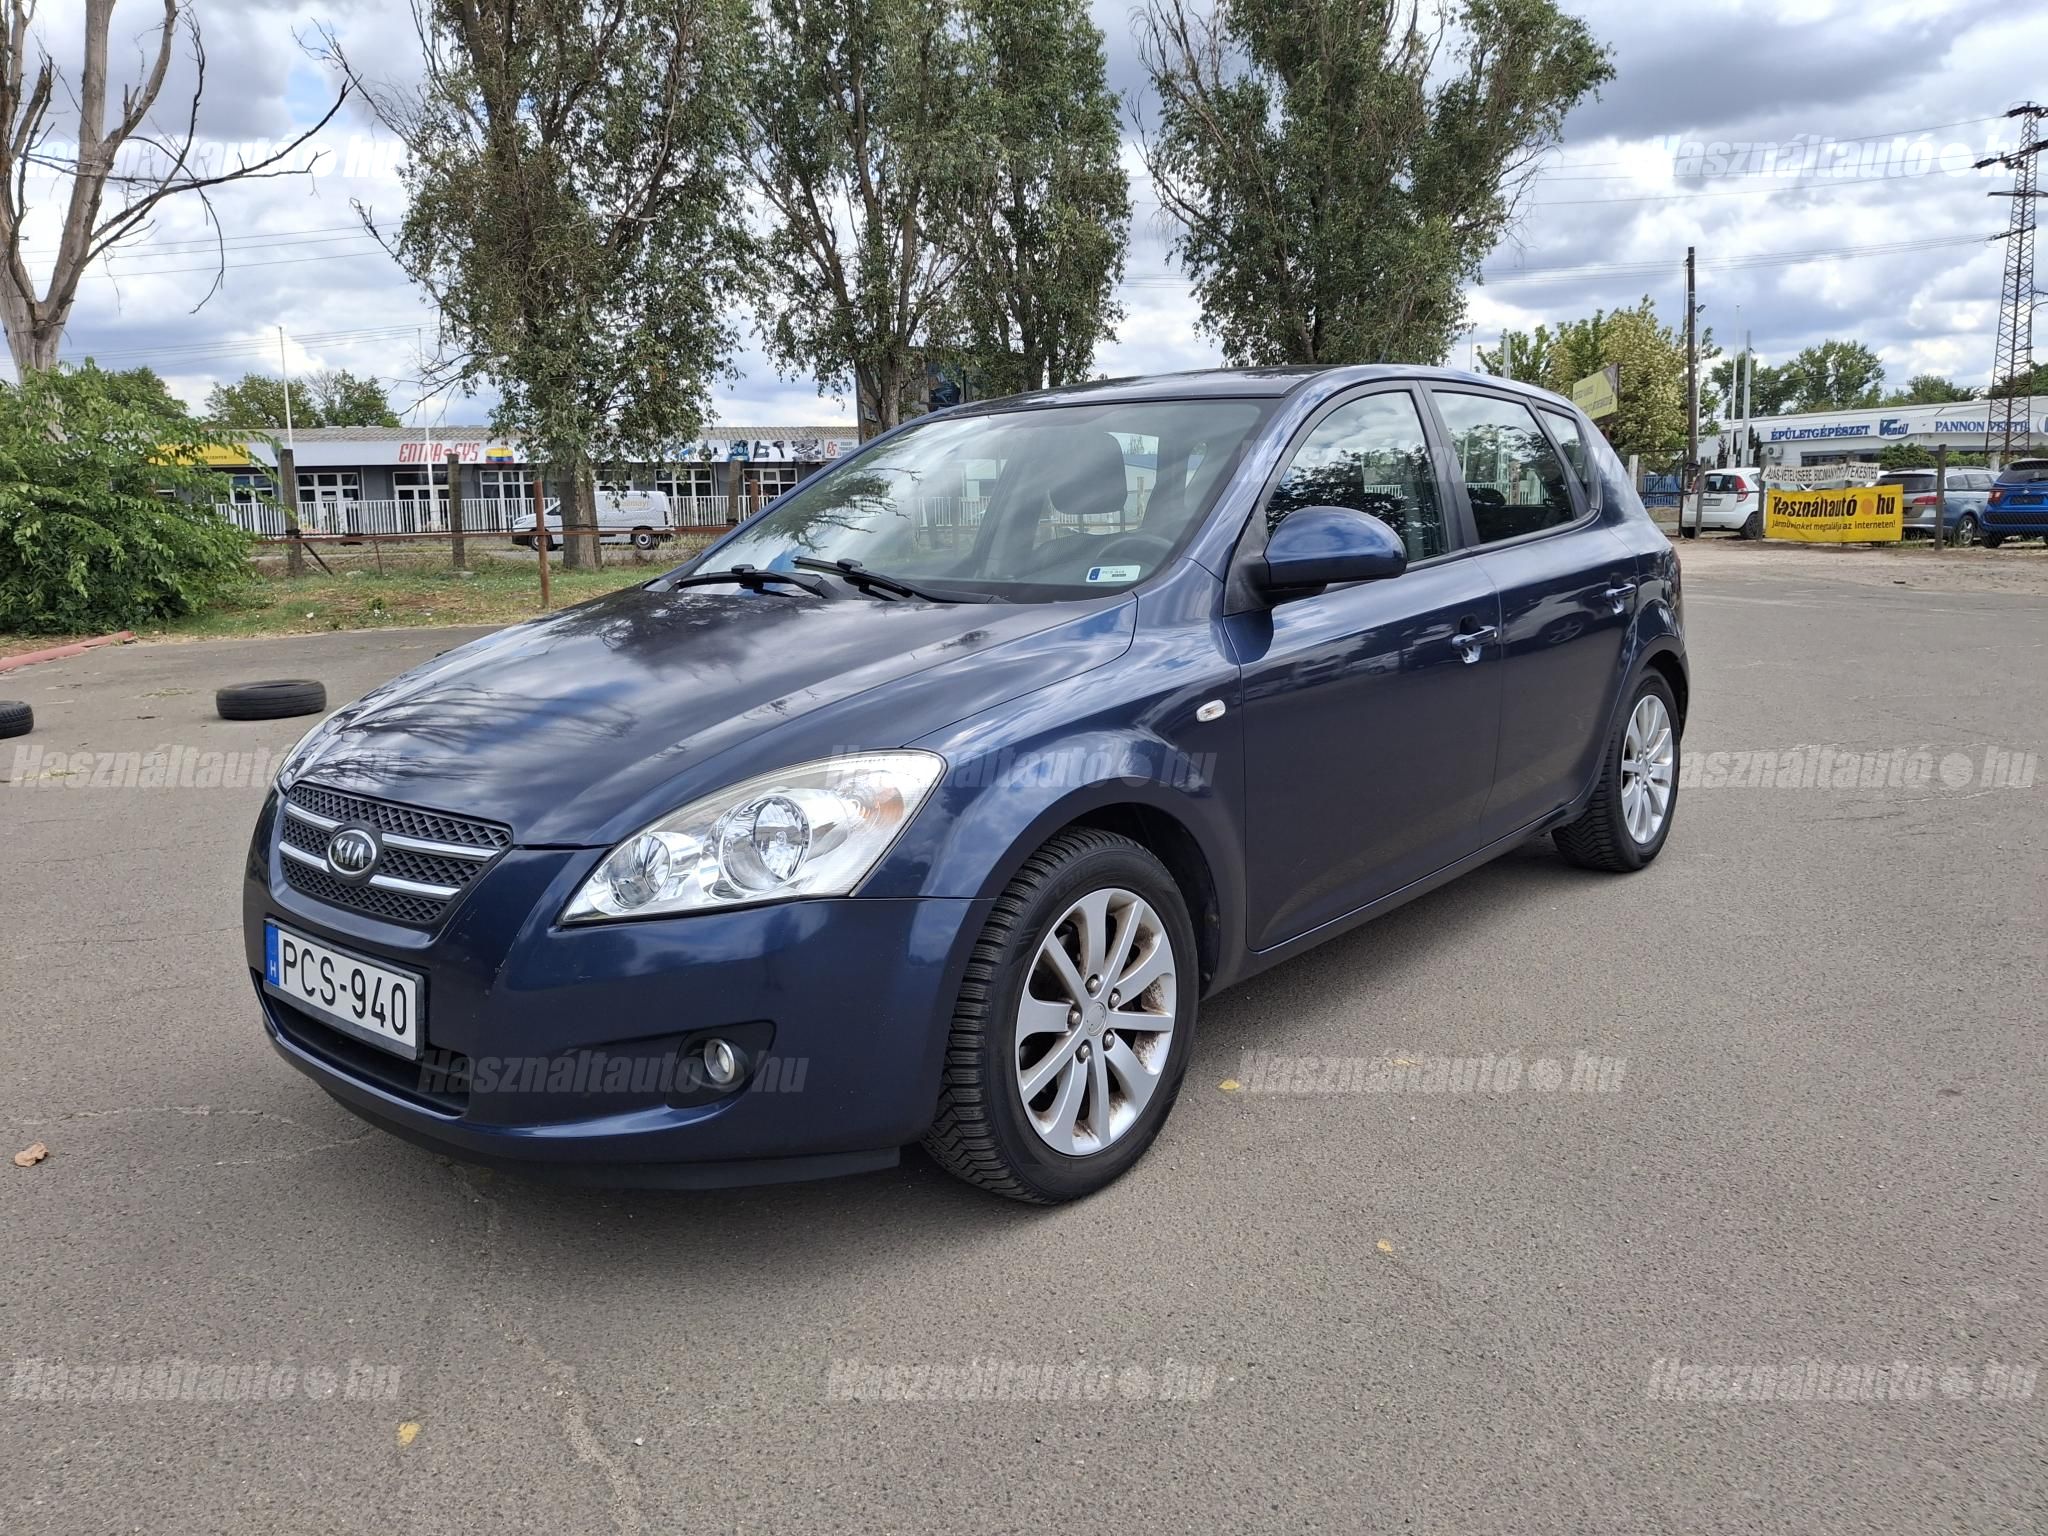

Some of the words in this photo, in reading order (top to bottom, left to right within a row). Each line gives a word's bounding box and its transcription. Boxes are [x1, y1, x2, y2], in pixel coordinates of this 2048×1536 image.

[1935, 421, 1985, 432] PANNON
[1772, 495, 1858, 518] Használtautó
[1876, 494, 1895, 515] hu
[1842, 522, 1852, 530] az
[334, 838, 365, 868] KIA
[270, 960, 277, 978] H
[283, 939, 408, 1037] PCS-940
